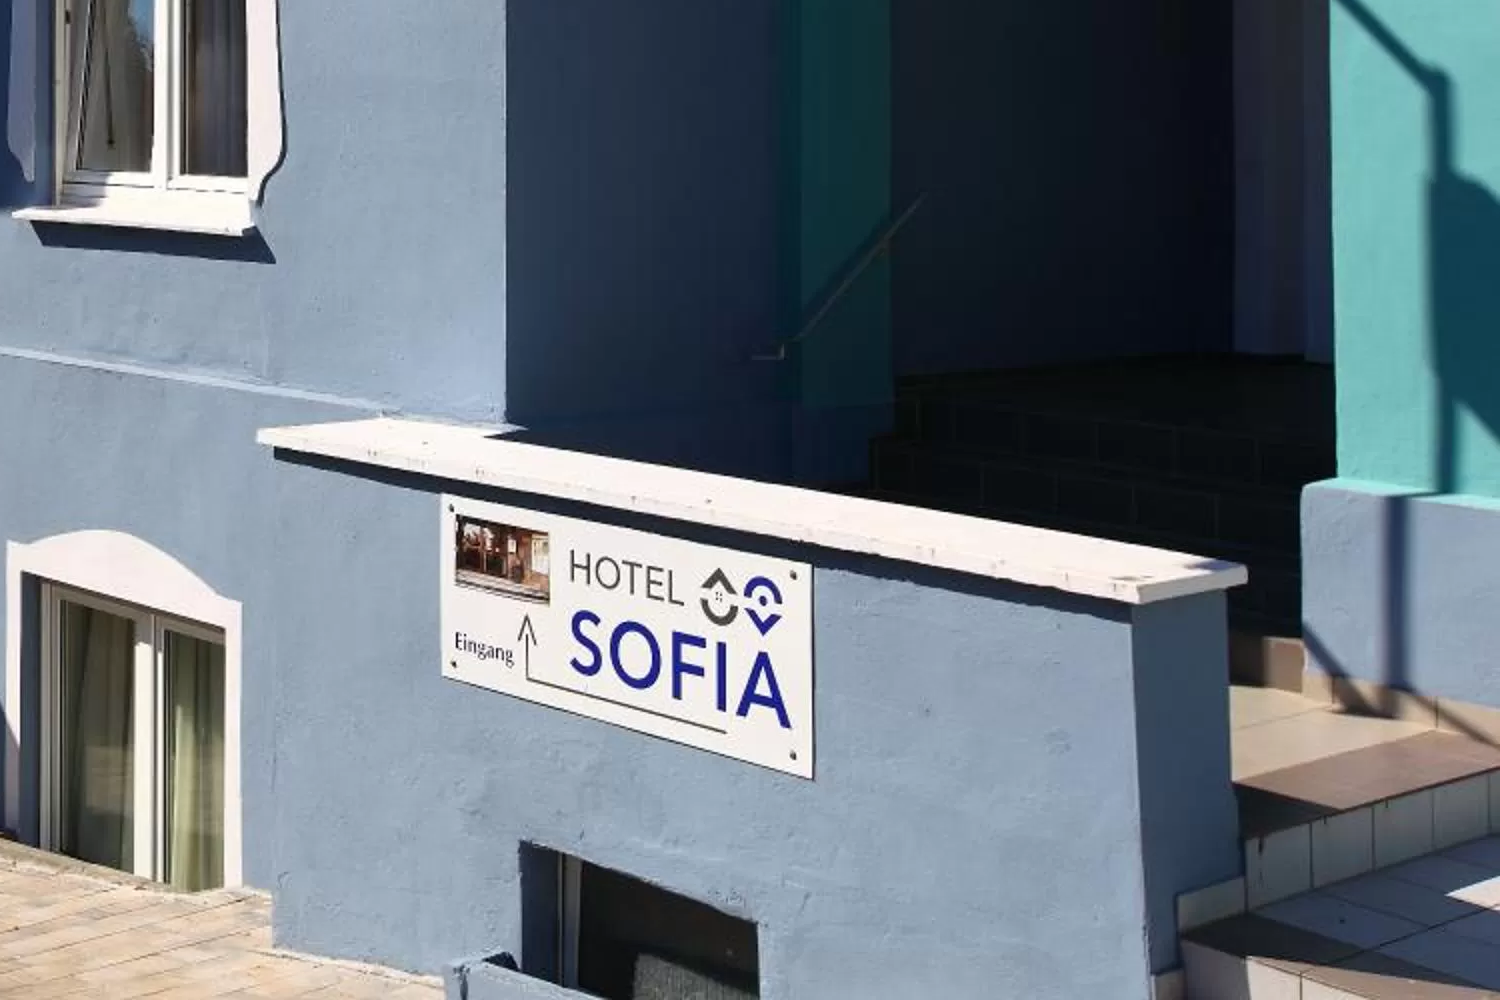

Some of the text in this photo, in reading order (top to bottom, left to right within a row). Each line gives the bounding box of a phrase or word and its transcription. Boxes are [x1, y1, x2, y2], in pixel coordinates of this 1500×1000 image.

[569, 549, 685, 607] HOTEL
[455, 631, 515, 669] Eingang
[569, 609, 792, 729] SOFIA
